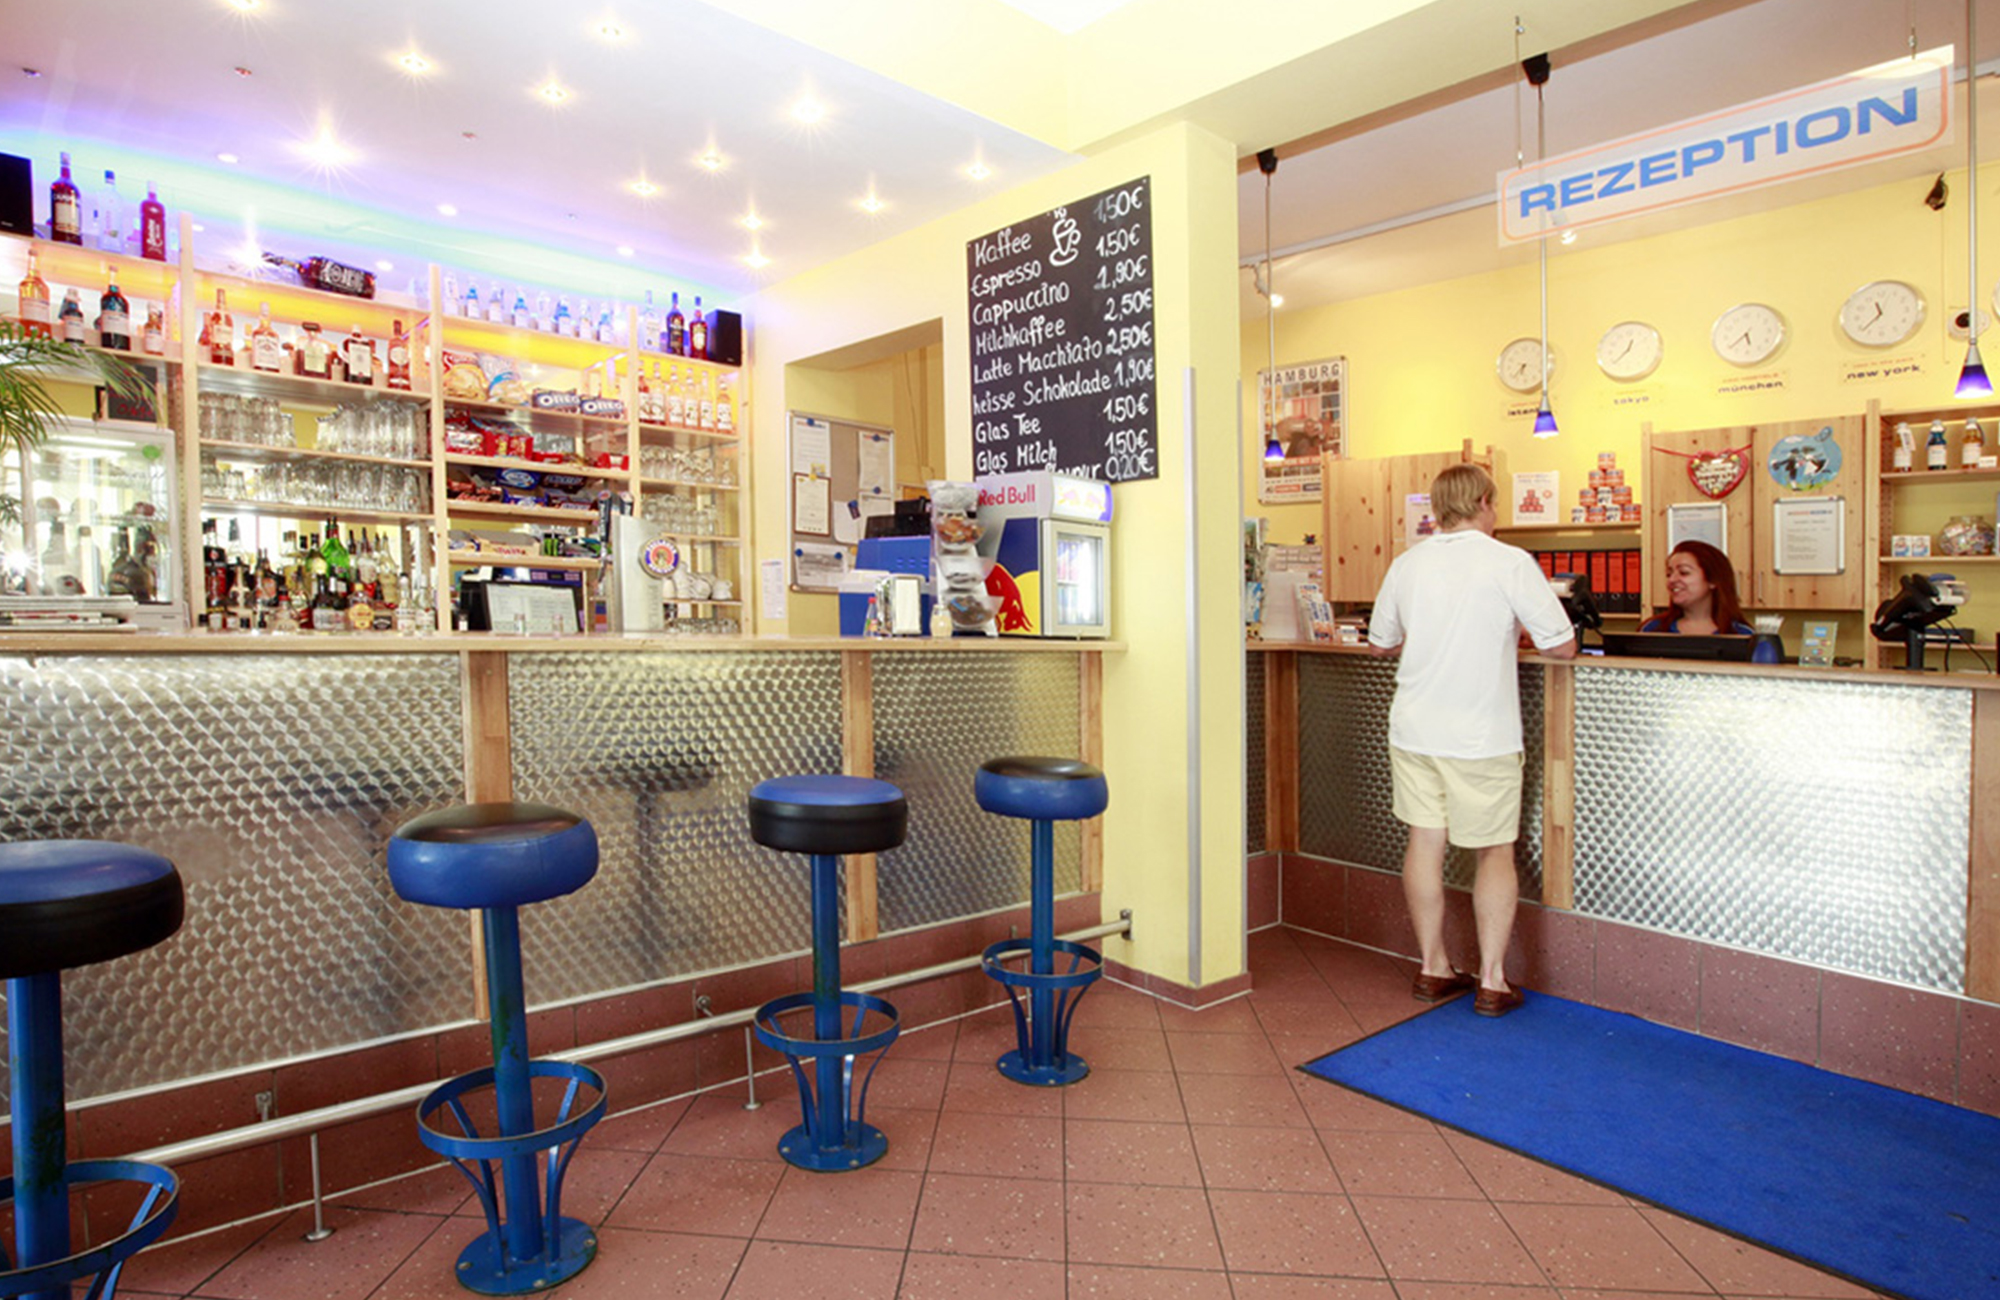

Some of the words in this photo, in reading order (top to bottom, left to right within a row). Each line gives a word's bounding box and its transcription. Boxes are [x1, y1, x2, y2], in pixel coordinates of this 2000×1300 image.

[1520, 86, 1918, 218] REZEPTION
[974, 227, 1032, 268] Kaffee
[1093, 185, 1144, 224] 1,50€
[971, 259, 1042, 297] Espresso
[1095, 222, 1141, 257] 1,50€
[972, 281, 1070, 326] Cappuccino
[976, 314, 1066, 356] Milchkaffee
[1103, 287, 1153, 322] 2,50€
[974, 356, 1013, 385] Latte
[1017, 335, 1103, 375] Macchiato
[1263, 362, 1340, 385] HAMBURG
[1846, 370, 1879, 380] new
[1883, 364, 1920, 377] york
[973, 390, 1016, 416] heisse
[1023, 368, 1112, 407] Schokolade
[1613, 395, 1650, 406] tokyo
[975, 420, 1011, 444] Glas
[1012, 412, 1042, 436] Tee
[976, 449, 1009, 472] Glas
[1017, 438, 1057, 467] Milch
[1104, 448, 1155, 482] 0,20€
[978, 486, 1006, 507] Red
[1007, 484, 1036, 505] Bull
